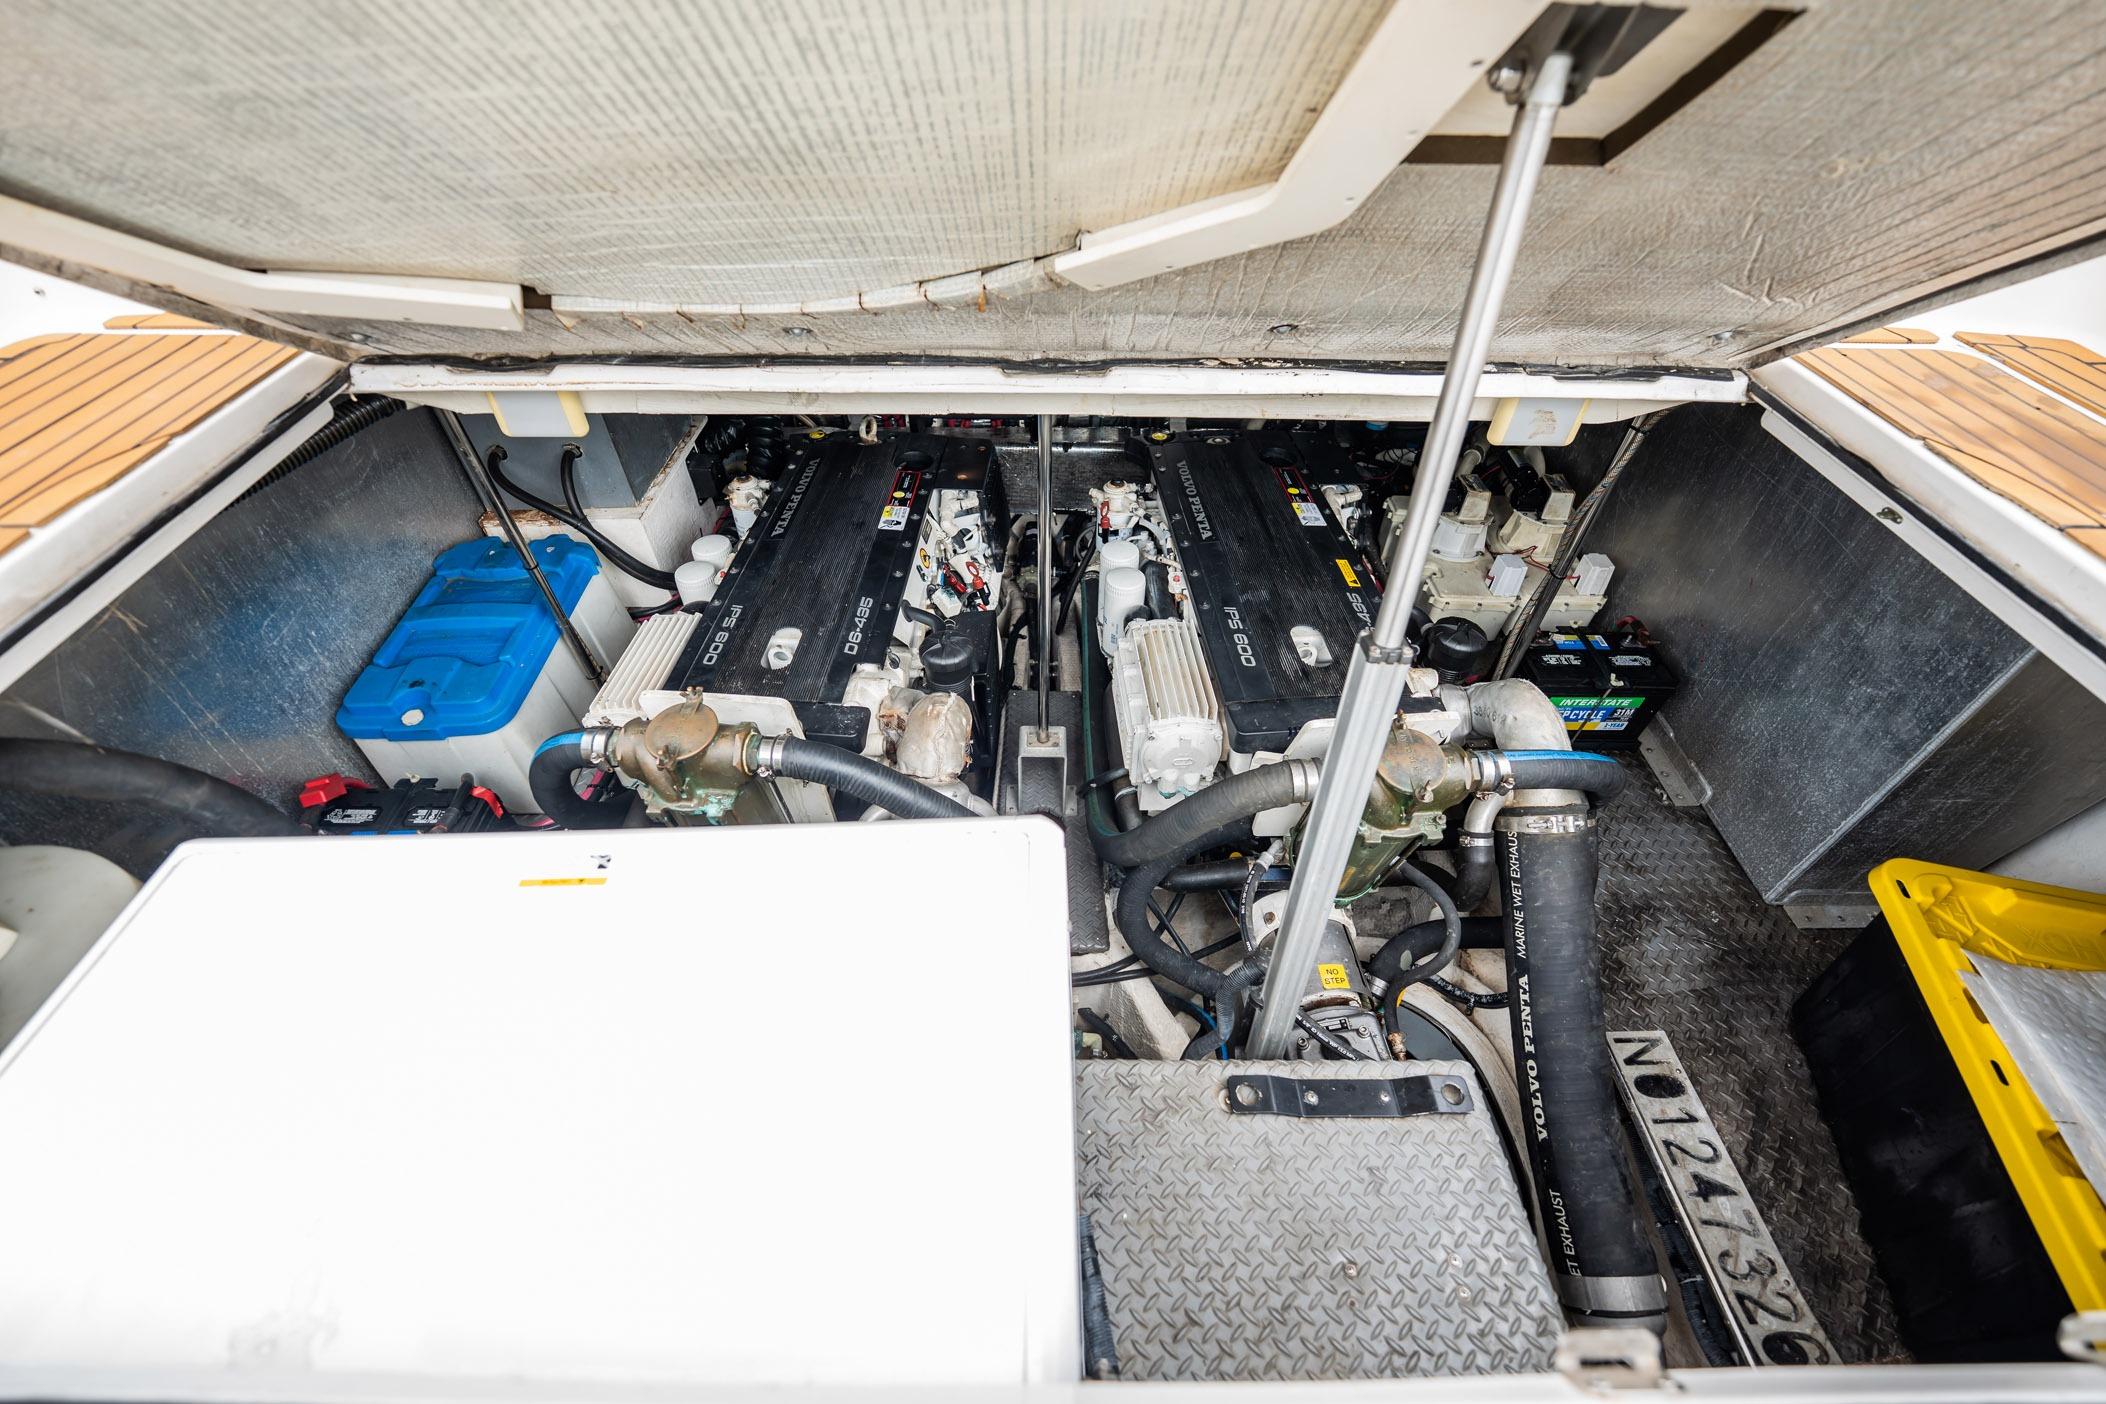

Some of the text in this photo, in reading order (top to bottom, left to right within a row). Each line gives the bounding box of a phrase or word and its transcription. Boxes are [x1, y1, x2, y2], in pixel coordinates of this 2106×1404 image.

[771, 458, 821, 537] VOLVO PENTA
[1176, 460, 1213, 540] VOLVO PENTA
[702, 604, 744, 665] IPS 600
[844, 596, 874, 655] D6-435
[1223, 606, 1256, 666] IPS 600
[1345, 592, 1375, 631] -435
[1324, 977, 1346, 985] STEP
[1507, 831, 1549, 1143] VOLVO PENTA MARINE WET EXHAUS
[1548, 1188, 1583, 1278] ET EXHAUST
